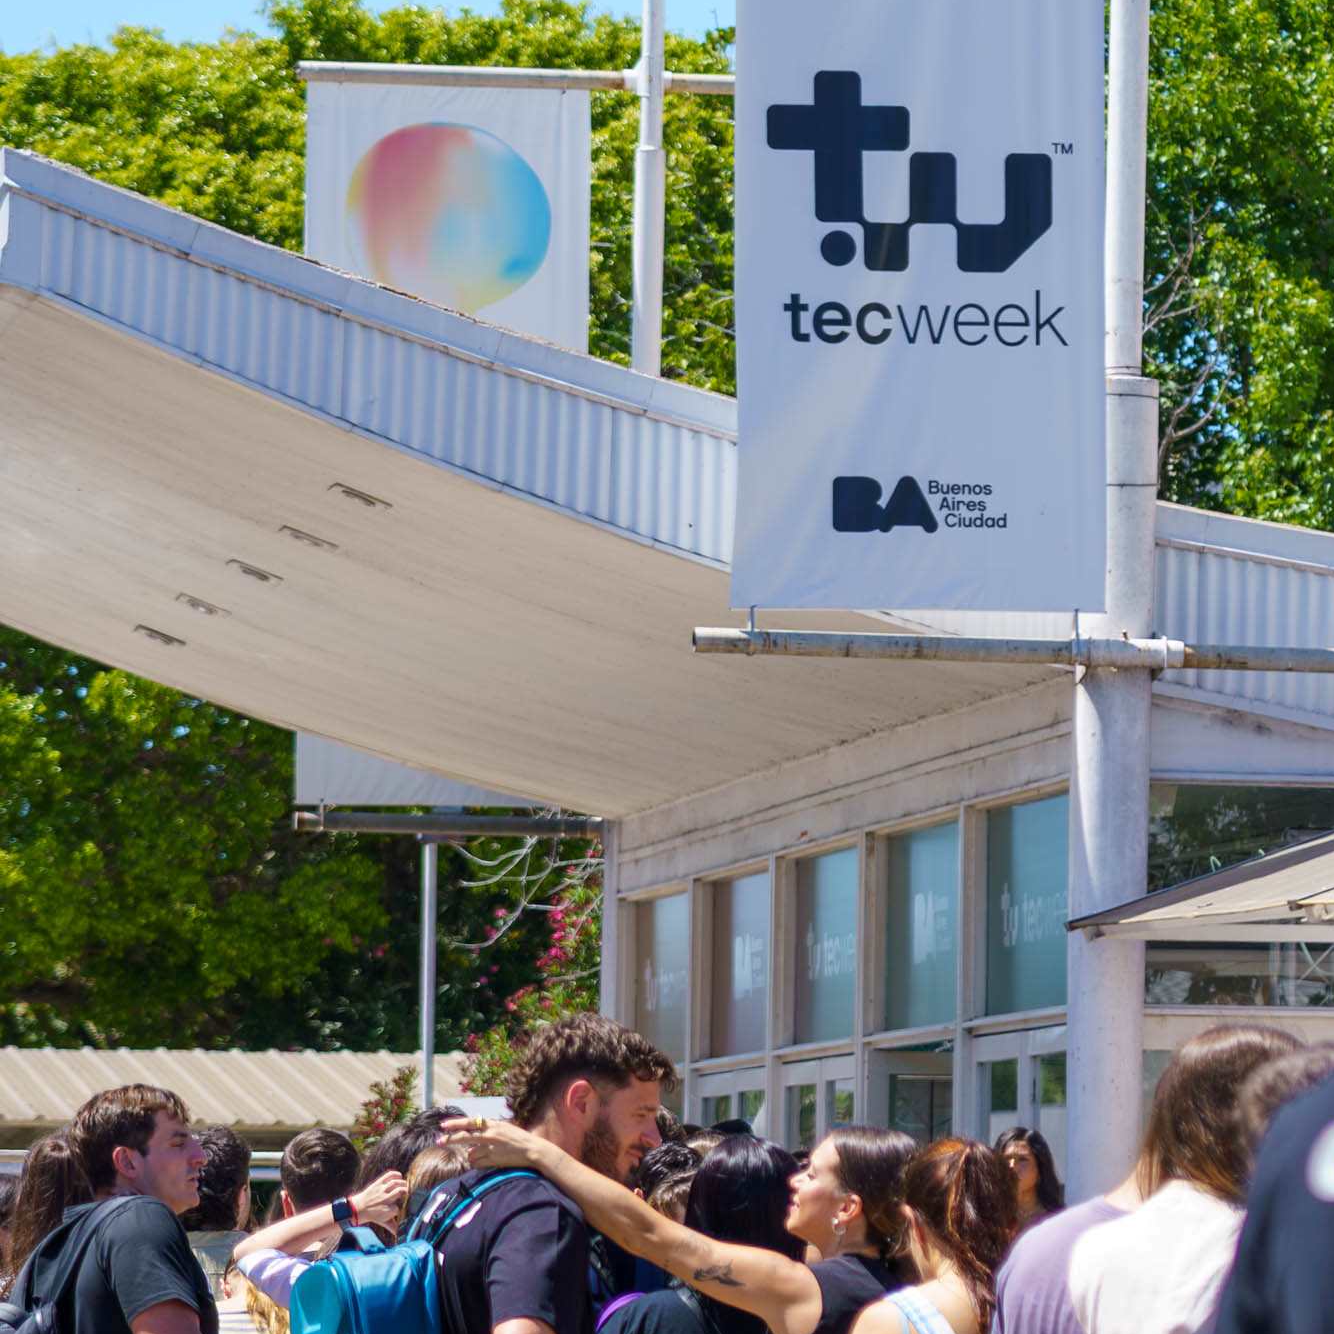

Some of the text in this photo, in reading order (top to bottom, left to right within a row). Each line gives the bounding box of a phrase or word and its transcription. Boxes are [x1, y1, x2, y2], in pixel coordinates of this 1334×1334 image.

[782, 290, 1069, 347] tecweek
[928, 480, 993, 496] Buenos
[832, 475, 938, 534] BA
[939, 497, 987, 512] Aires
[944, 513, 1008, 529] Ciudad
